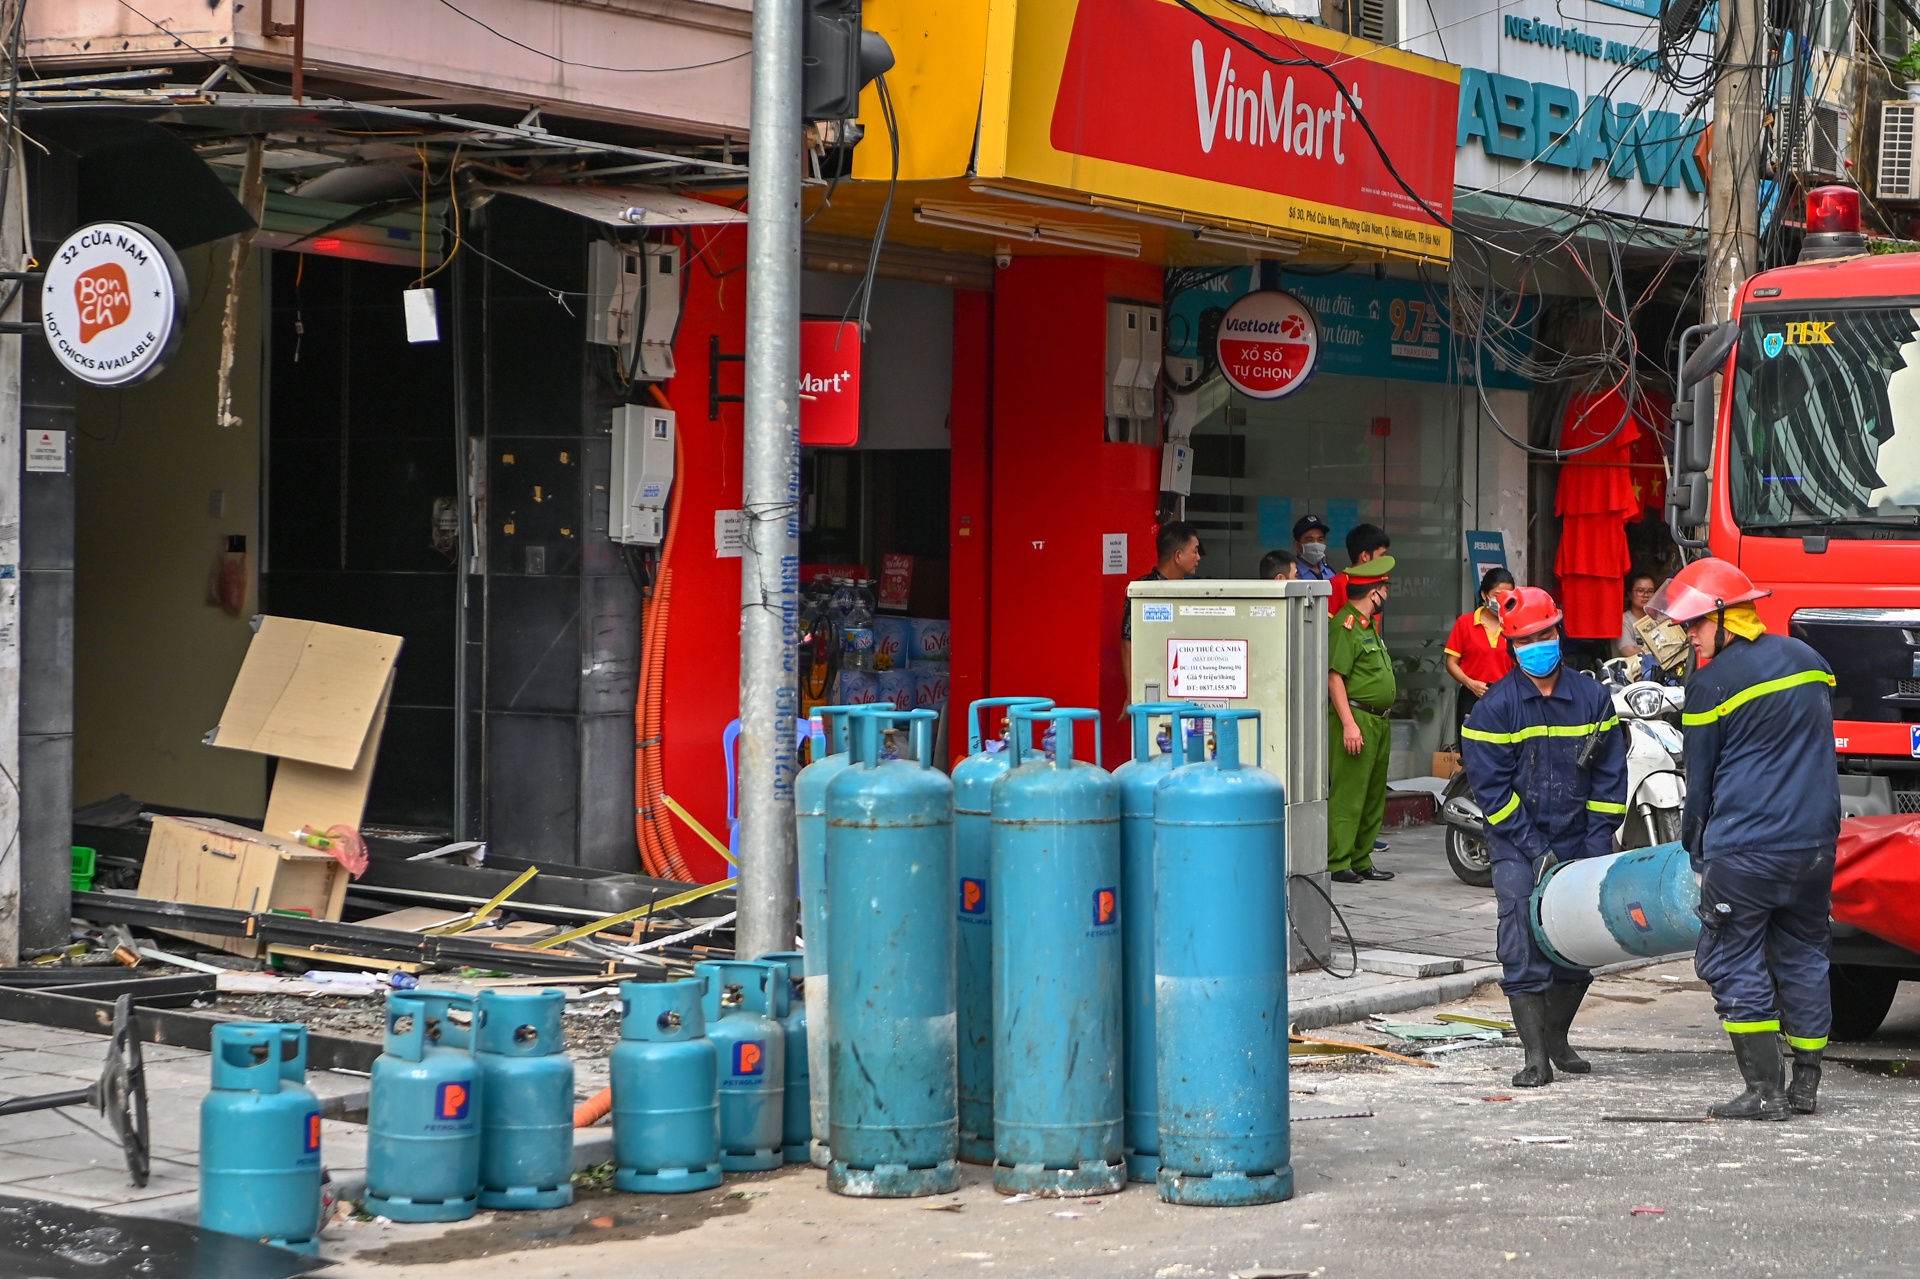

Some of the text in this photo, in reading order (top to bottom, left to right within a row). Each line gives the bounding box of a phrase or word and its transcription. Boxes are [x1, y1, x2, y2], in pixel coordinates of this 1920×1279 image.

[1604, 40, 1628, 65] AN
[1456, 67, 1706, 193] ABBANK
[1289, 206, 1297, 219] Số
[1297, 207, 1305, 222] 30,
[1306, 209, 1317, 223] Phố
[1327, 214, 1341, 229] Nam,
[1371, 223, 1384, 237] Nam,
[60, 229, 148, 266] 32 CỬA NAM
[1226, 318, 1280, 334] Vietlott
[45, 311, 157, 371] HOT CHICKS AVAILABLE
[1241, 344, 1282, 362] XỔ SỐ
[798, 370, 851, 393] Mart+
[1233, 365, 1292, 382] TỰ CHỌN
[1195, 645, 1214, 653] THUÊ
[1226, 644, 1241, 653] NHÀ
[1835, 737, 1849, 748] er
